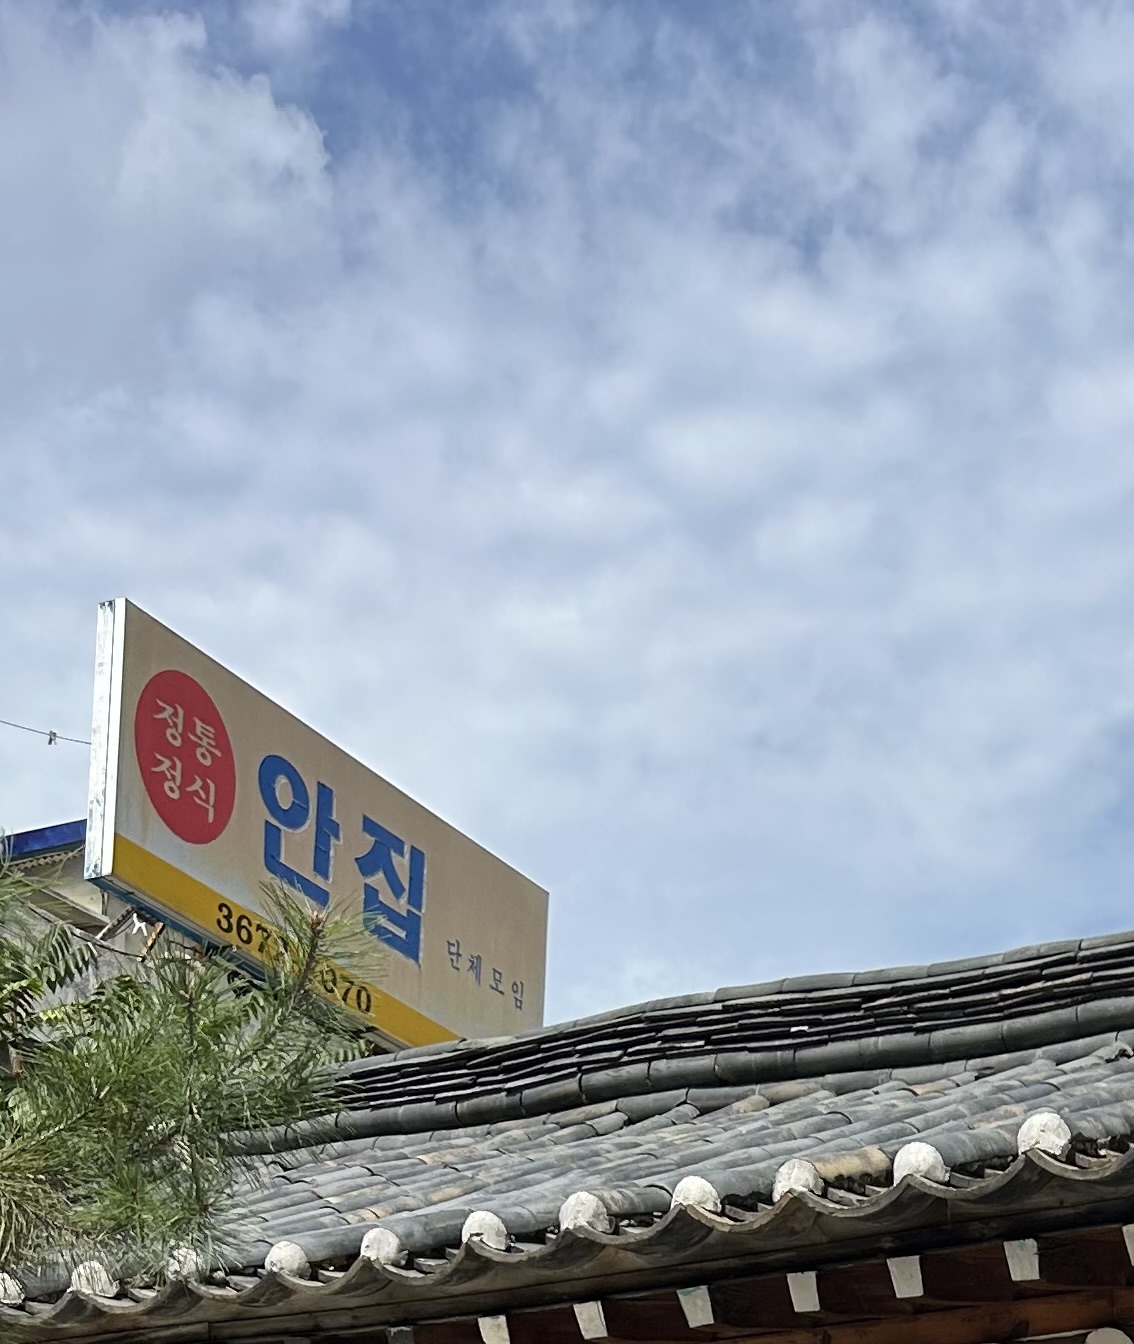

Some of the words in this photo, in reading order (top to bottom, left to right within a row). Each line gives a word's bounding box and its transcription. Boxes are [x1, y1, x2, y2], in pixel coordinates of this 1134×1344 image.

[152, 698, 222, 767] 정통
[151, 751, 216, 824] 정식
[257, 754, 426, 964] 안집
